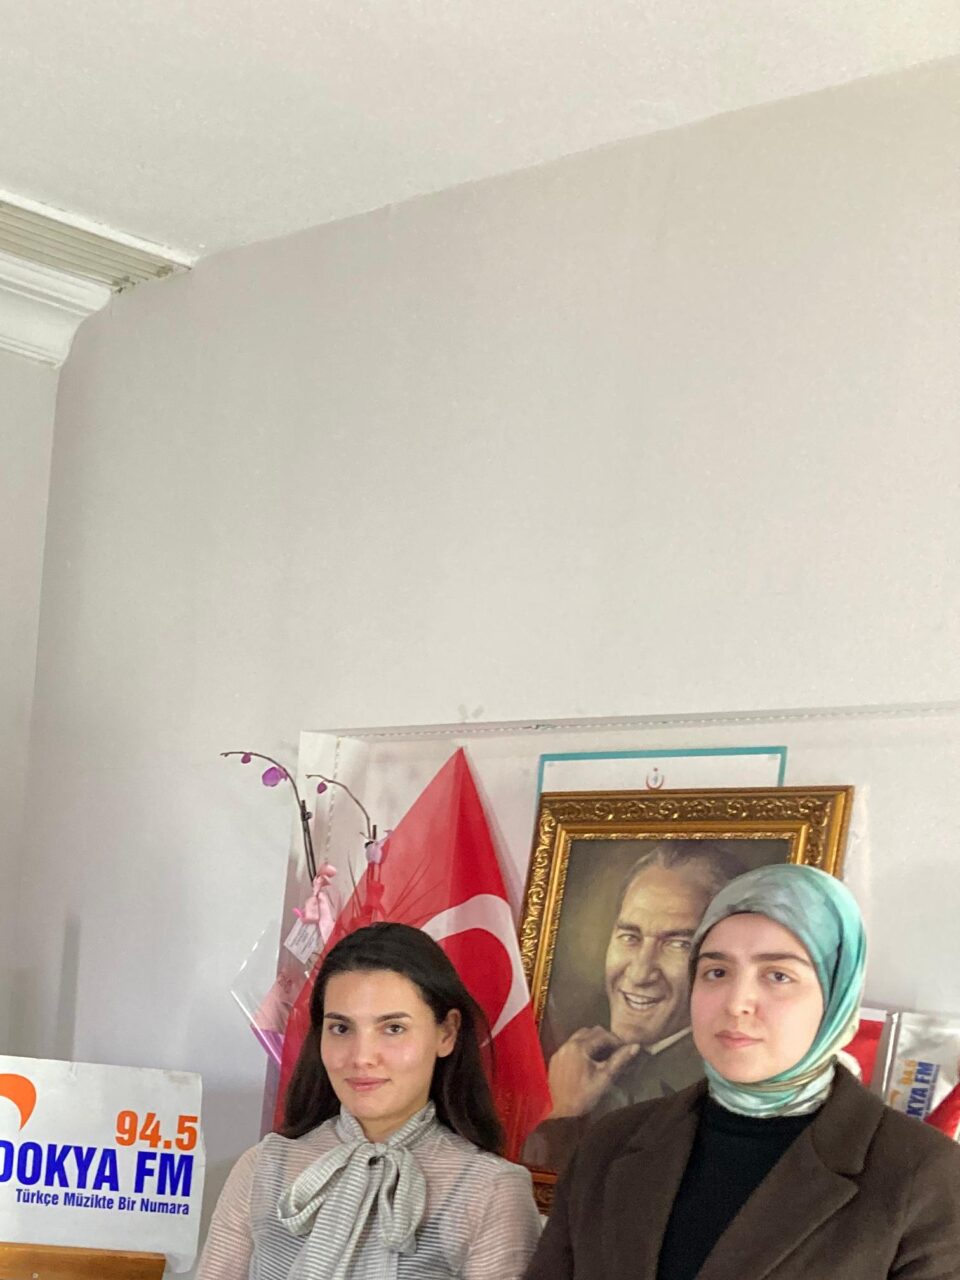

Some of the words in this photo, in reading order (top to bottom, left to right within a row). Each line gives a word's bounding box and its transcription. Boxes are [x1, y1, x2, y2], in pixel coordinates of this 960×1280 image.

[915, 1061, 934, 1083] FM
[115, 1110, 198, 1151] 94.5
[134, 1151, 194, 1197] FM
[16, 1188, 59, 1207] Türkçe
[63, 1192, 114, 1210] Müzikte
[118, 1196, 136, 1211] Bir
[140, 1198, 190, 1215] Numara
